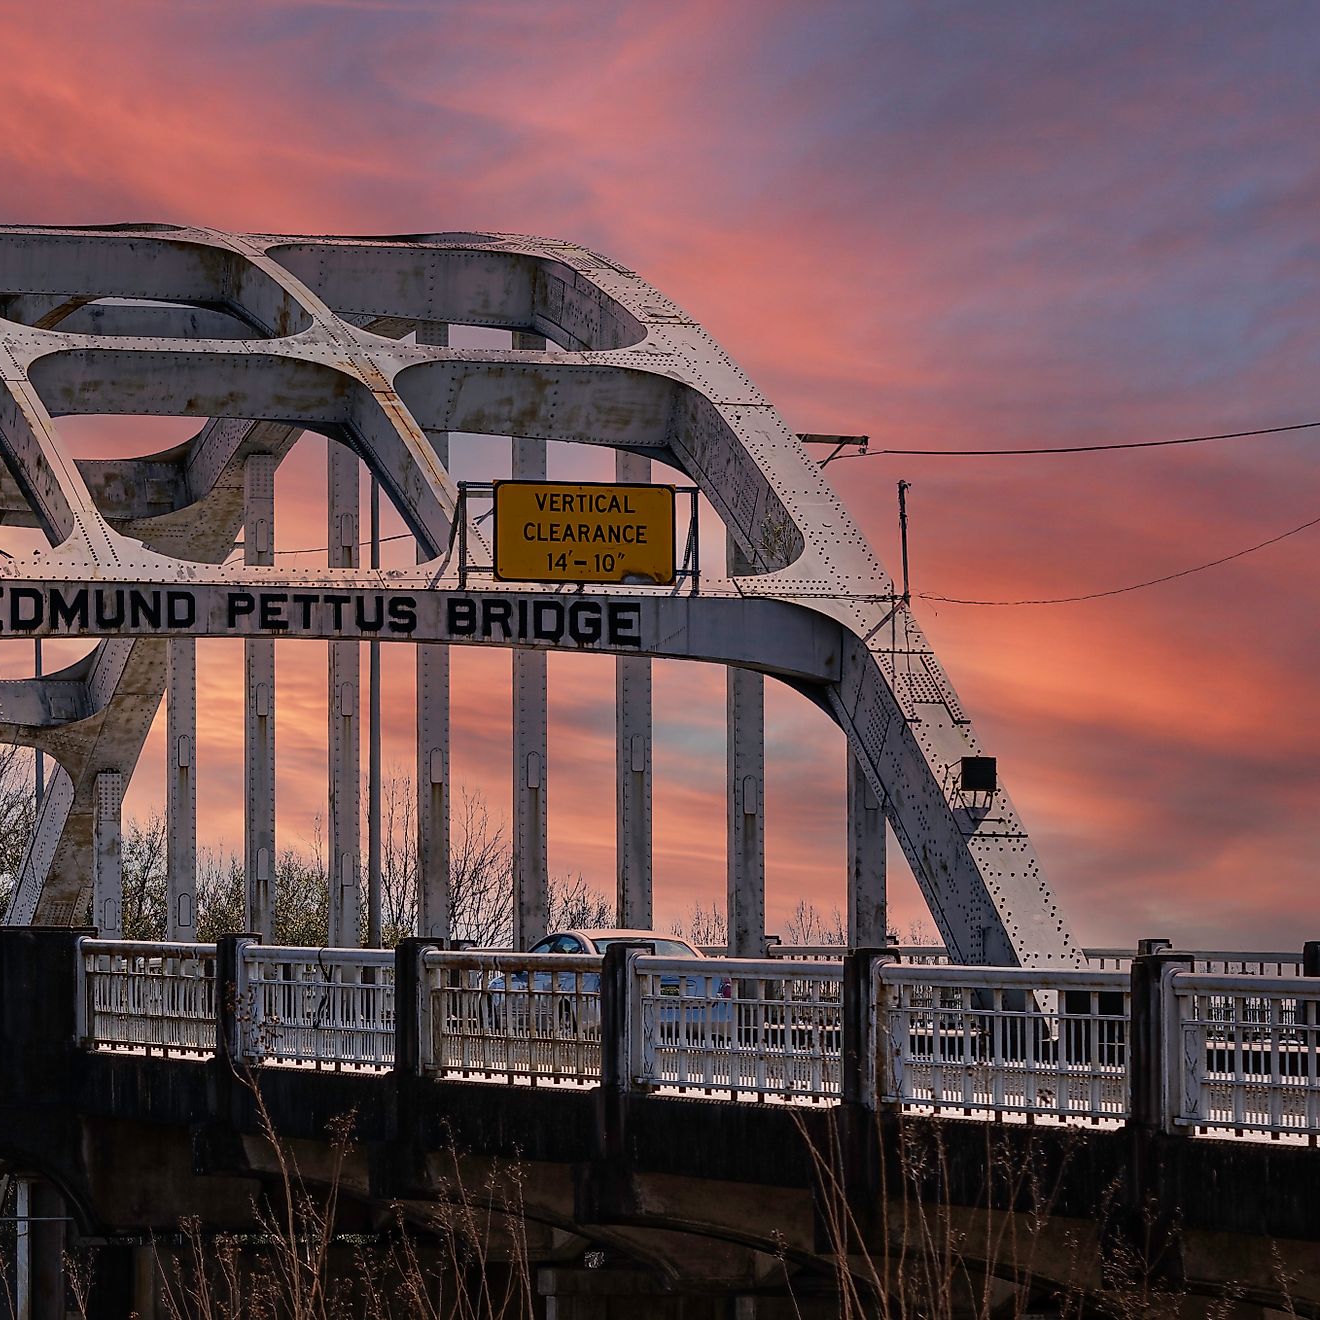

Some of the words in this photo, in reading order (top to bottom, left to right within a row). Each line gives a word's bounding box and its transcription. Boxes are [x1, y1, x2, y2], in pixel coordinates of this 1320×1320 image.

[535, 493, 636, 514] VERTICAL
[523, 522, 647, 544] CLEARANCE
[227, 592, 417, 633] PETTUS
[447, 597, 641, 647] BRIDGE
